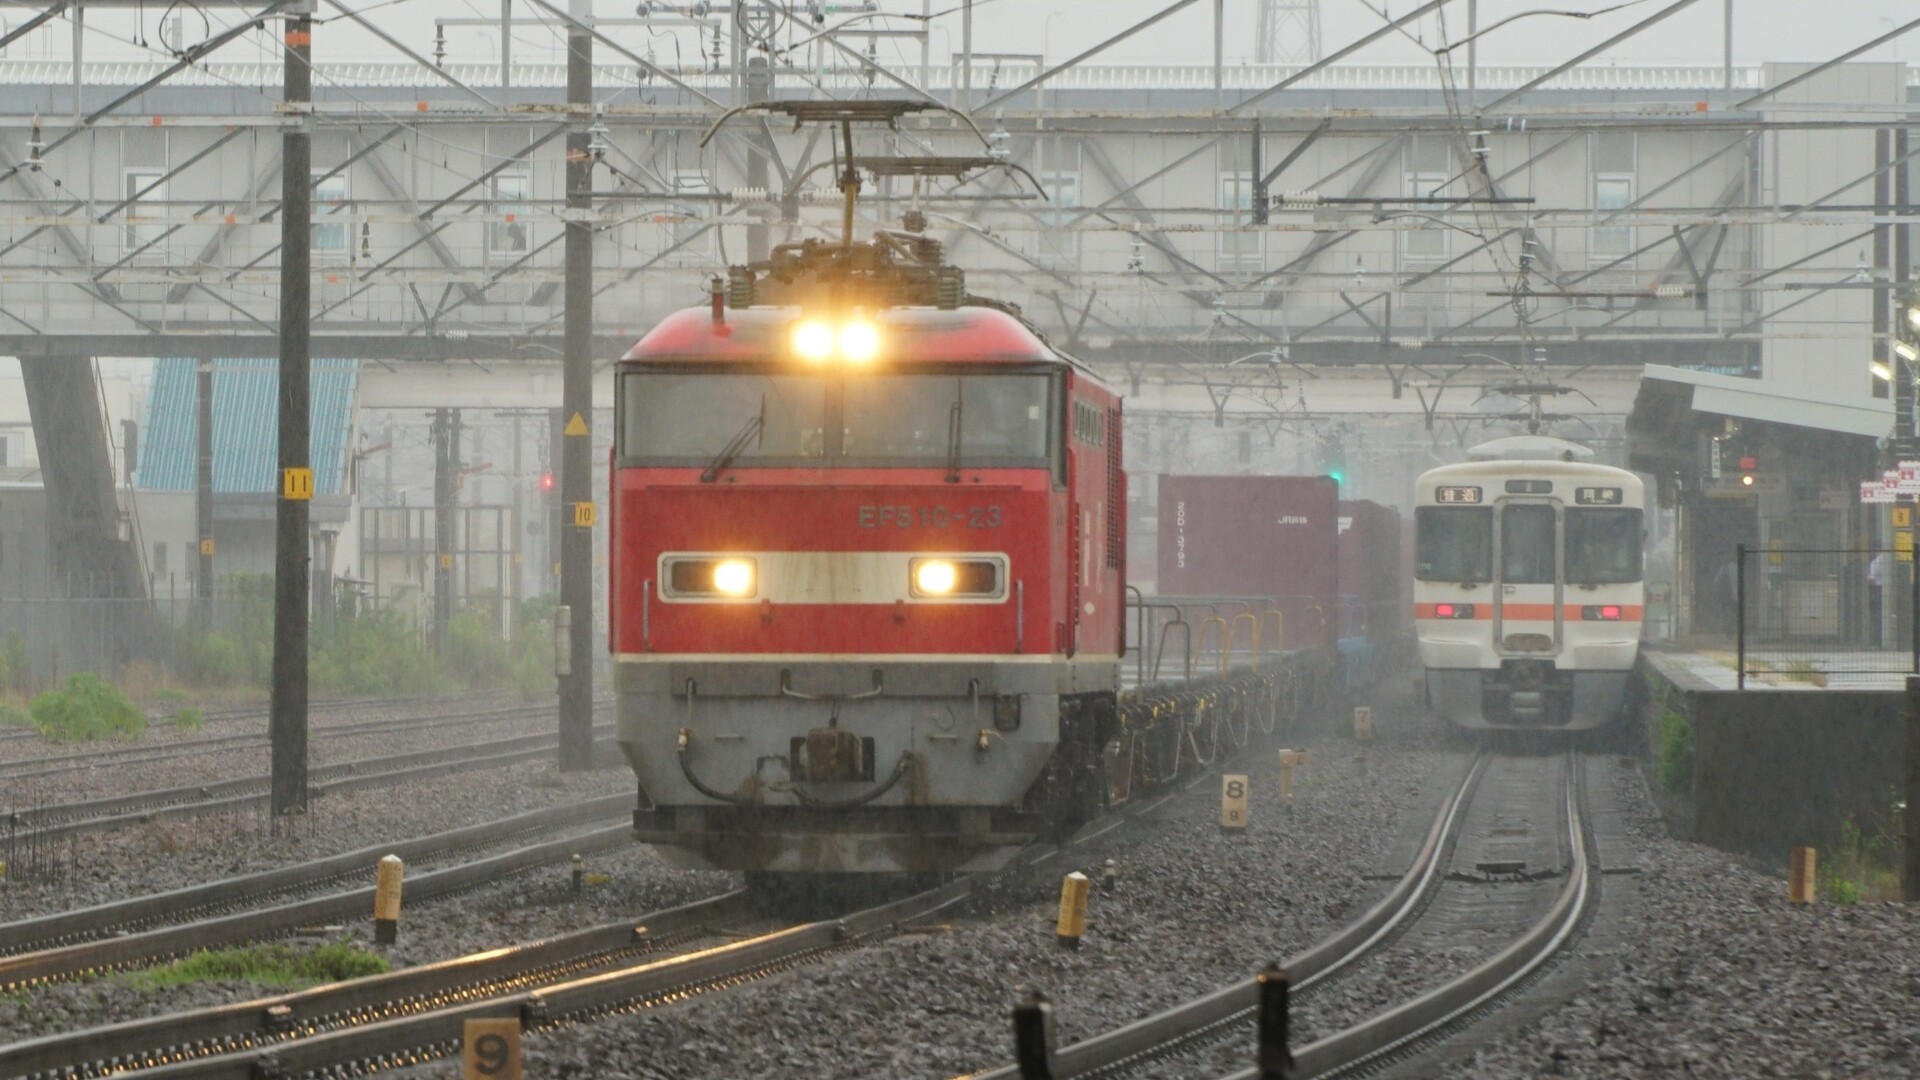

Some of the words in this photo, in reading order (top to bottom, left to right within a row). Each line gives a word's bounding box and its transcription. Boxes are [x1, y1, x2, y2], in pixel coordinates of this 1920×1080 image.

[291, 474, 307, 492] 11
[579, 507, 591, 522] 10
[857, 505, 1003, 529] EF510-23
[1226, 780, 1244, 799] 8
[475, 1033, 509, 1076] 9
